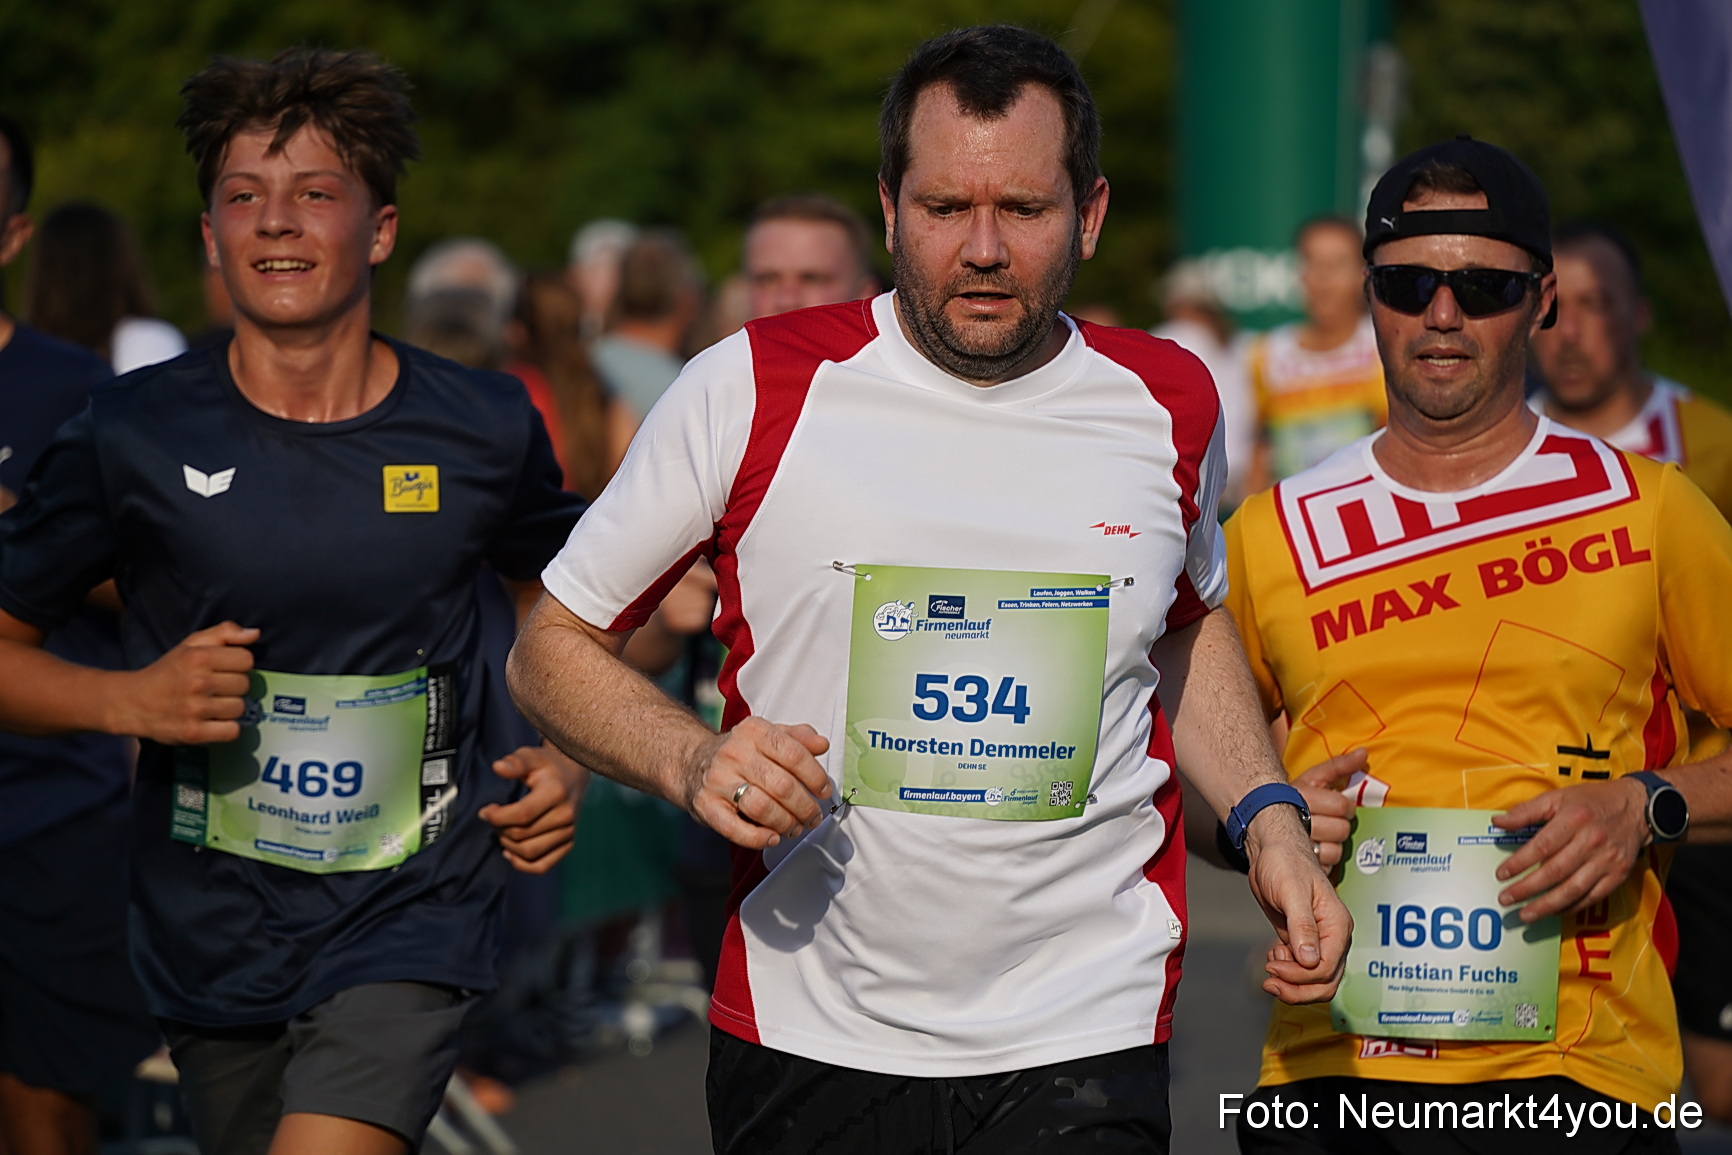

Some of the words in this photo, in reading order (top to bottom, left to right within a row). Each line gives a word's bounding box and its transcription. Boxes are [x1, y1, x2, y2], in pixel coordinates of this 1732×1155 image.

[1103, 525, 1131, 536] DEHN
[1075, 589, 1096, 597] Walken
[1310, 572, 1461, 651] MAX
[1477, 526, 1652, 600] BÖGL
[936, 604, 963, 613] Fischer
[1000, 601, 1018, 609] Essen,
[915, 618, 992, 632] Firmenlauf
[944, 631, 990, 640] neumarkt
[912, 673, 1031, 724] 534
[867, 730, 963, 756] Thorsten
[969, 738, 1076, 760] Demmeler
[957, 762, 977, 770] DEHN
[261, 756, 364, 797] 469
[903, 789, 981, 803] firmenlauf.bayern
[1003, 794, 1038, 803] Firmenlauf
[247, 797, 331, 825] Leonhard
[336, 804, 380, 824] Weiß
[1386, 853, 1452, 866] Firmenlauf
[1410, 865, 1451, 873] neumarkt
[1376, 904, 1502, 951] 1660
[1368, 960, 1453, 981] Christian
[1459, 965, 1519, 984] Fuchs
